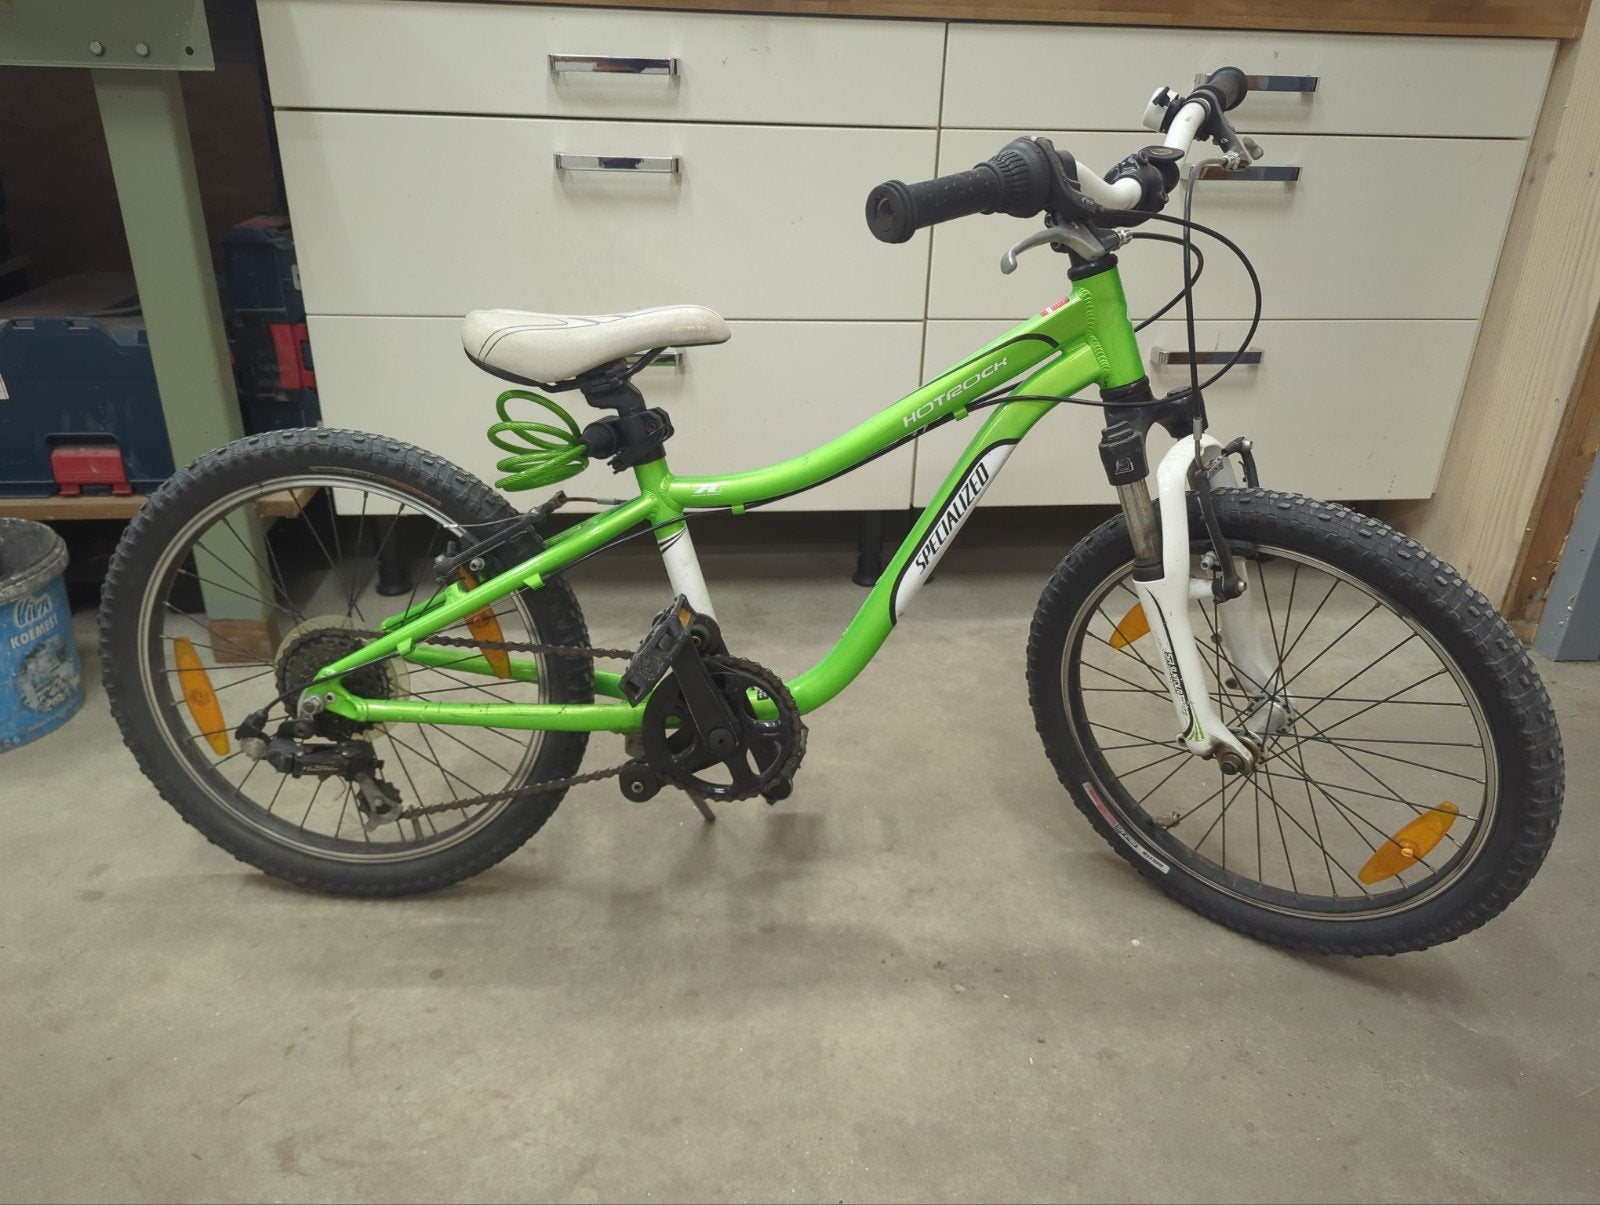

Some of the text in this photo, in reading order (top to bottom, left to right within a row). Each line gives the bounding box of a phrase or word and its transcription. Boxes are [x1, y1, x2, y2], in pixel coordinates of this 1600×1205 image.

[903, 357, 1008, 428] HOTROCK
[914, 461, 990, 576] SPECIALIZED
[10, 613, 59, 650] KOEMEST
